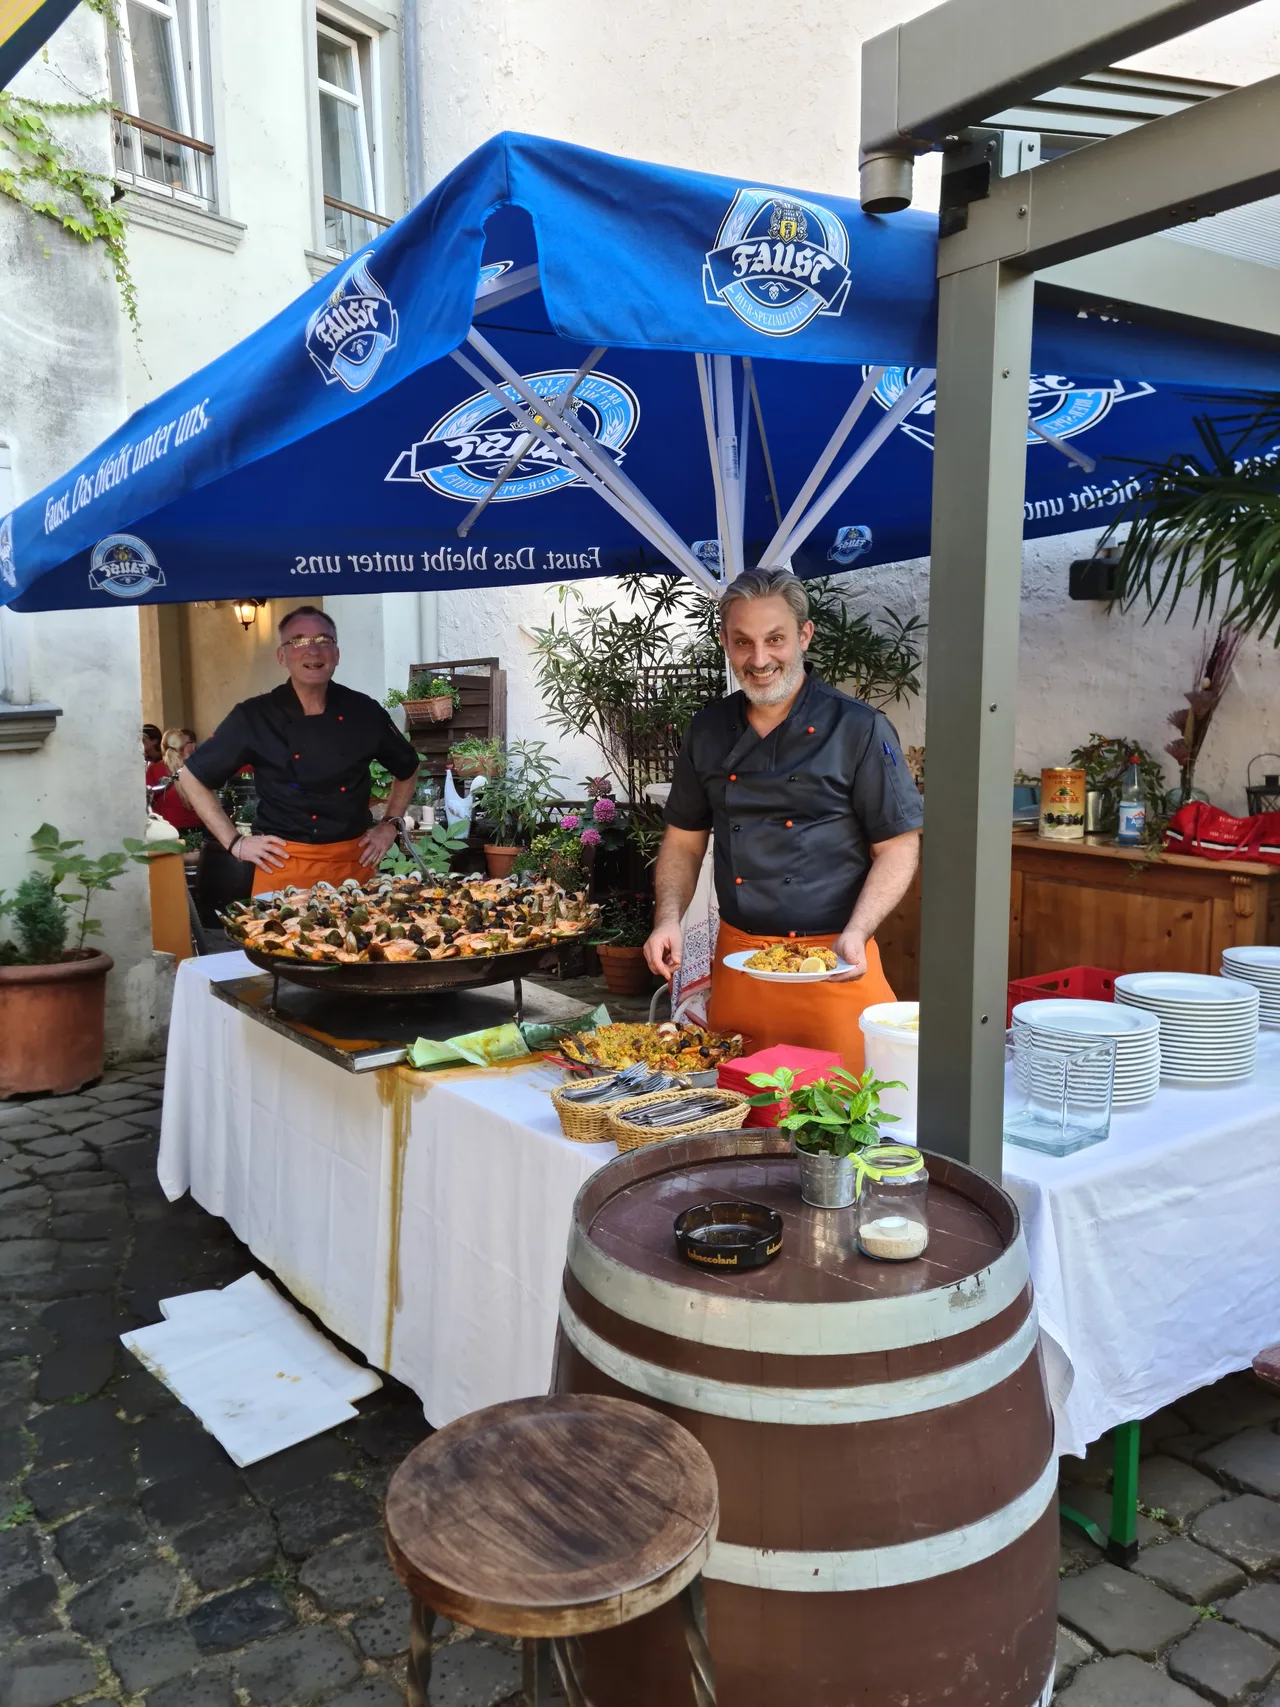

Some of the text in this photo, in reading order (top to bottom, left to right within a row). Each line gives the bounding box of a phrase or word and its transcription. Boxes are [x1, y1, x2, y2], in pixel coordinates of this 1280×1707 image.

[731, 241, 836, 285] FAUST
[315, 299, 380, 351] FAUST
[44, 397, 210, 535] Faust. Das bleibt unter uns.
[687, 1247, 738, 1265] tobaccoland
